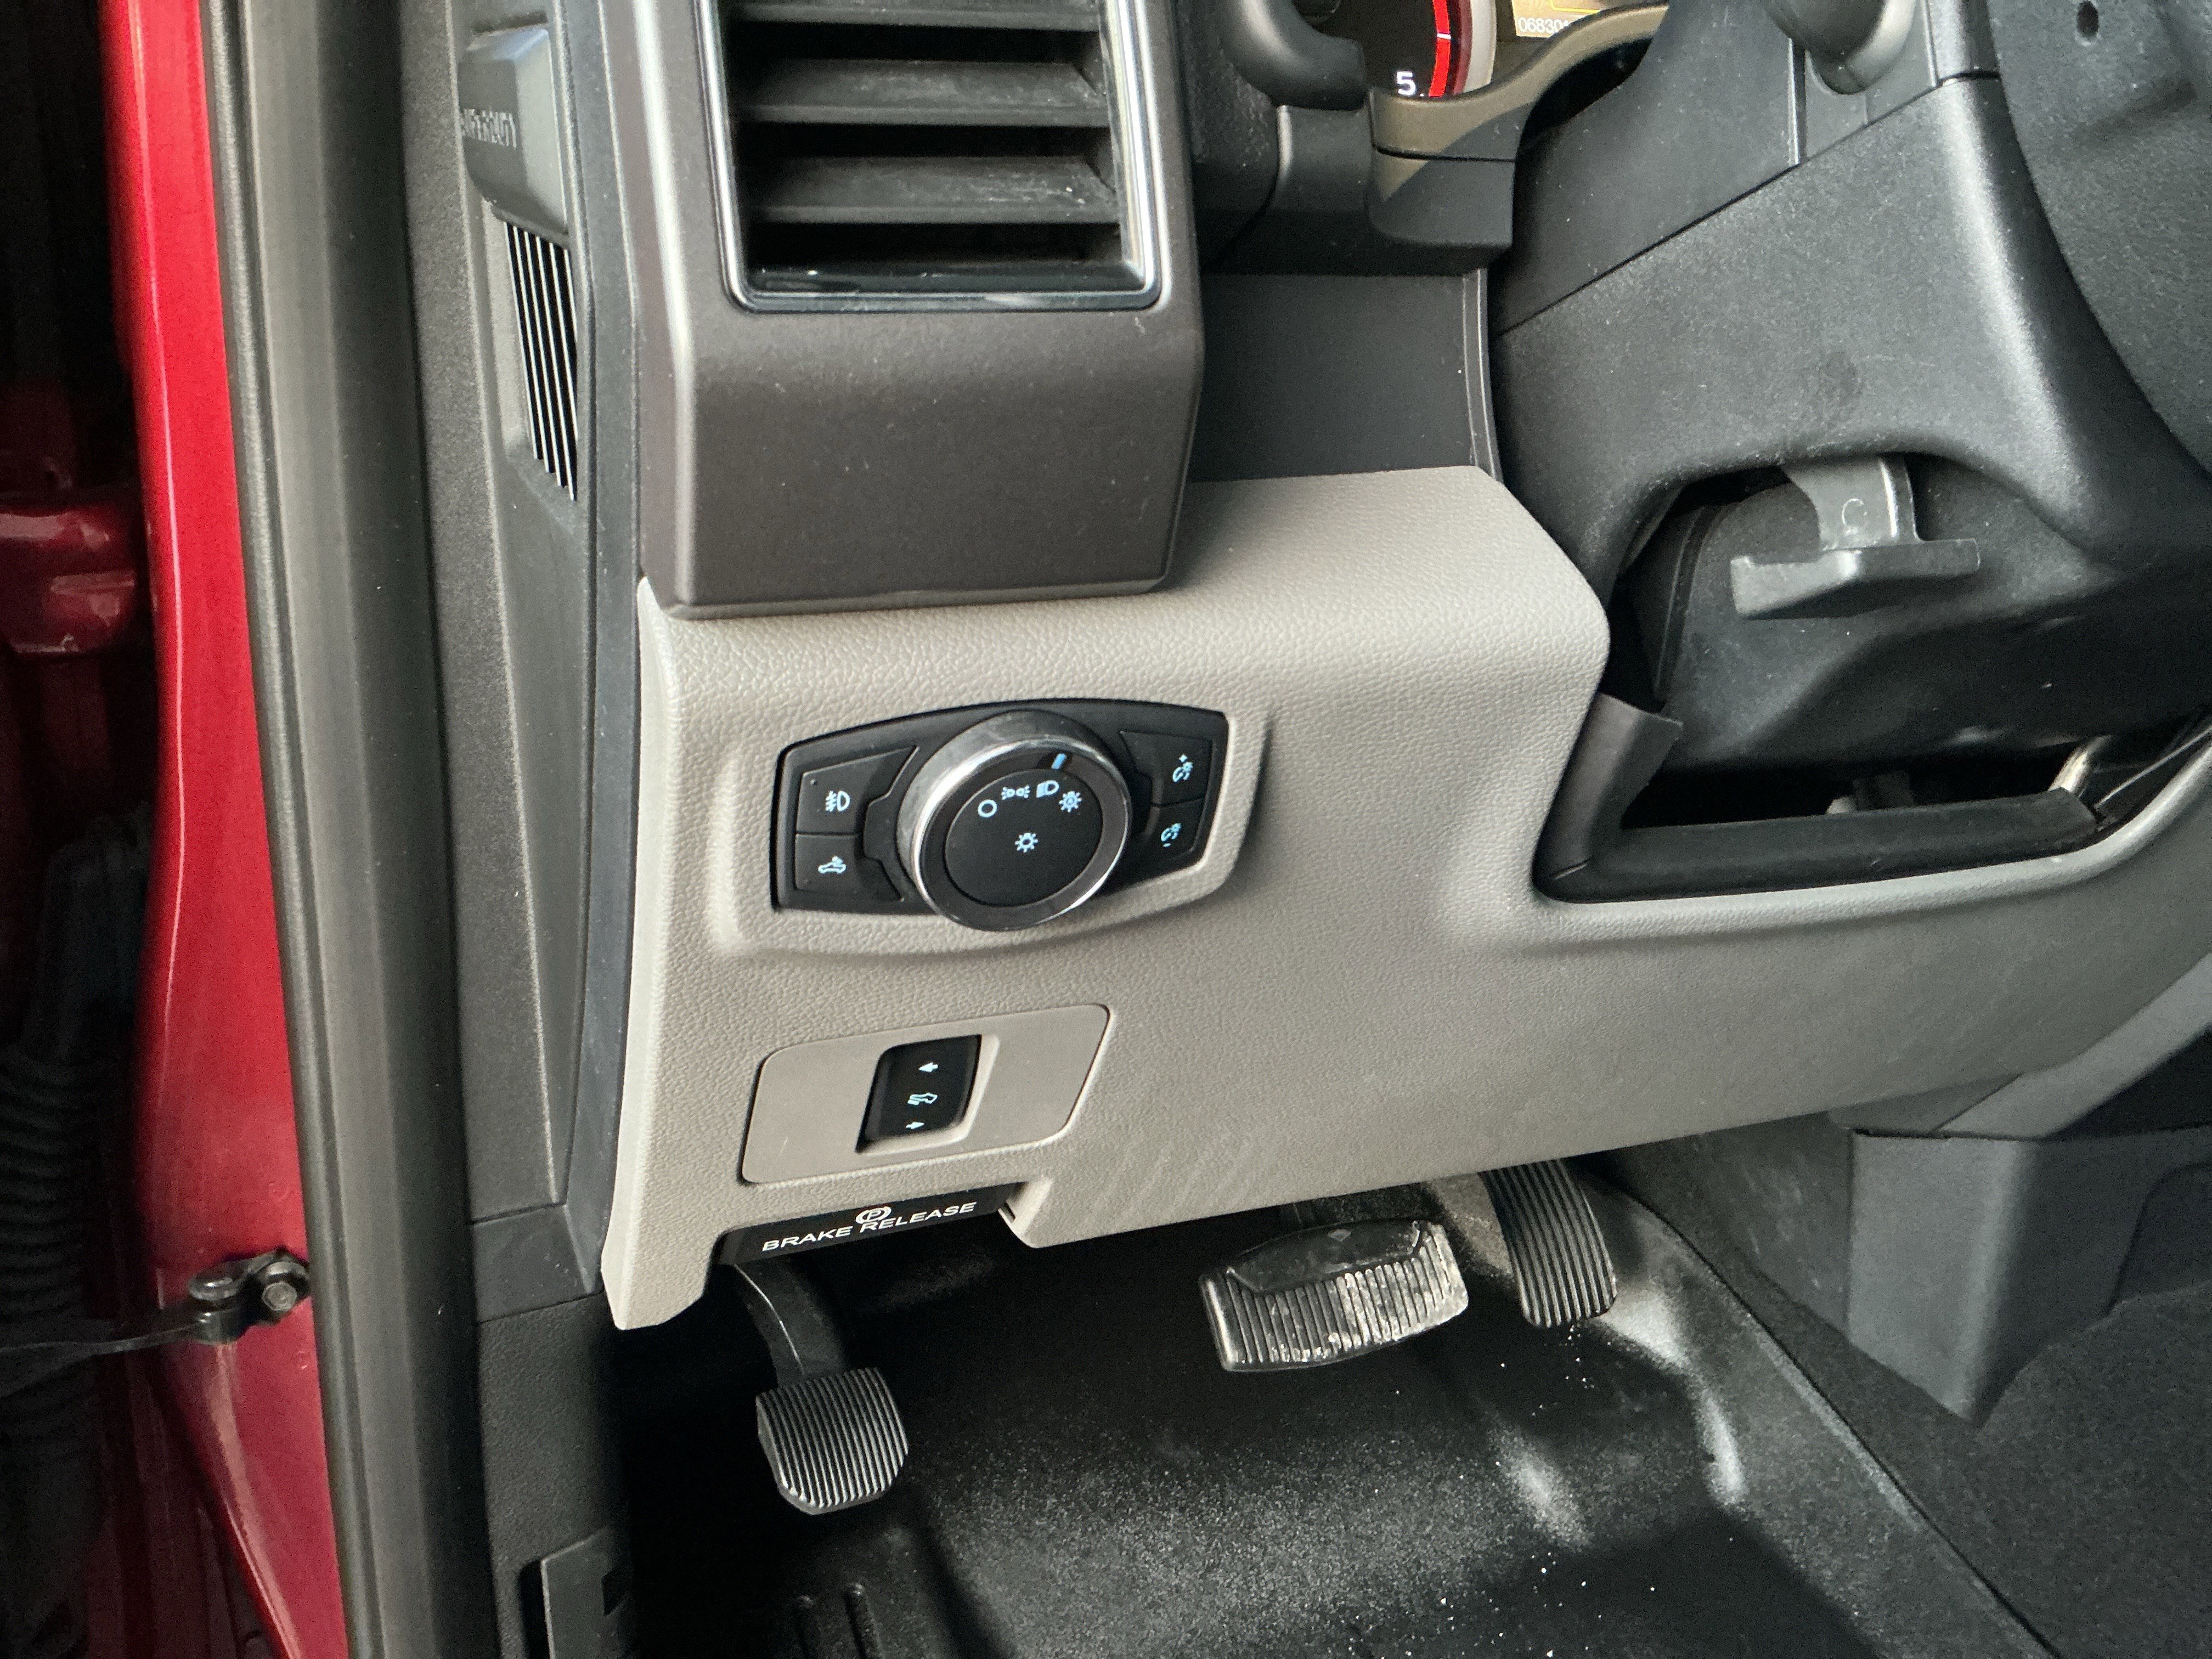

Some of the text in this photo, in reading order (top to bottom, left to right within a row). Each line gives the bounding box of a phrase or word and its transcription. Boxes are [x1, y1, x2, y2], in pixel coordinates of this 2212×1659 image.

[1396, 71, 1417, 95] 5
[761, 1201, 978, 1252] BRAKE RELEASE
